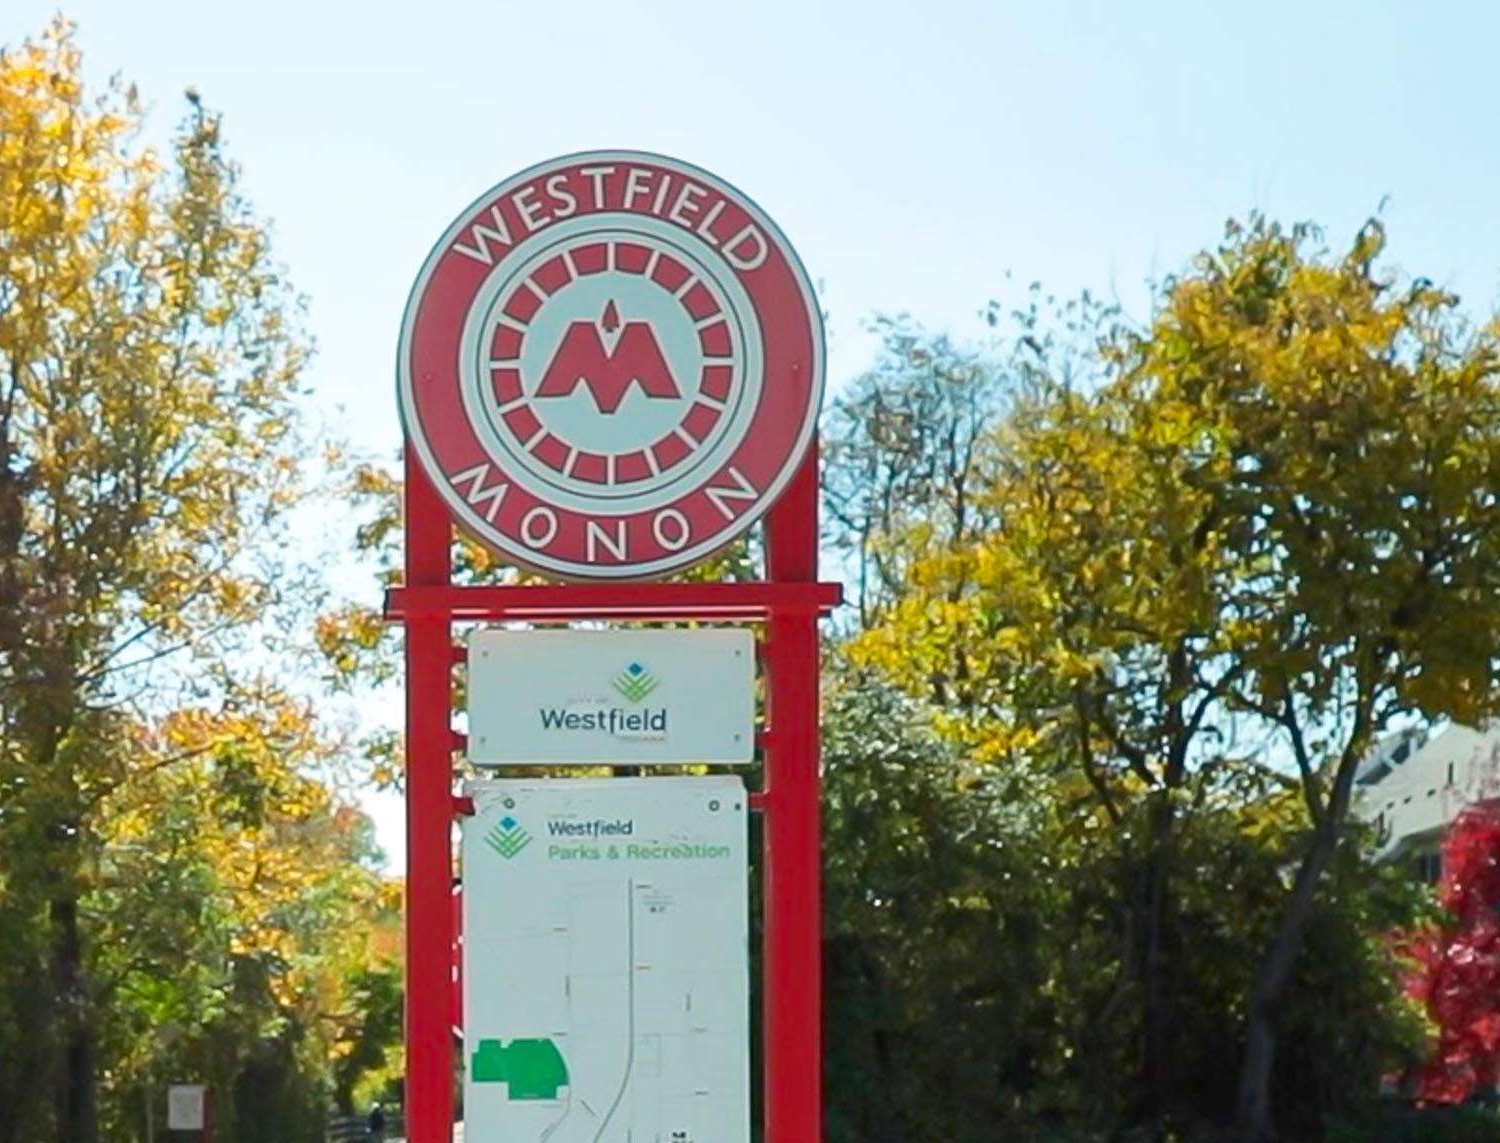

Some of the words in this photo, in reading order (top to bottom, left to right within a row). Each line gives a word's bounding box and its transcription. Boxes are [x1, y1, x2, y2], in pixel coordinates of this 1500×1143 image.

[452, 167, 769, 271] WESTFIELD
[449, 463, 760, 562] MONON
[540, 708, 667, 735] Westfield
[548, 820, 633, 838] Westfield
[548, 845, 601, 860] Parks
[607, 845, 619, 860] &
[627, 844, 731, 860] Recreation
